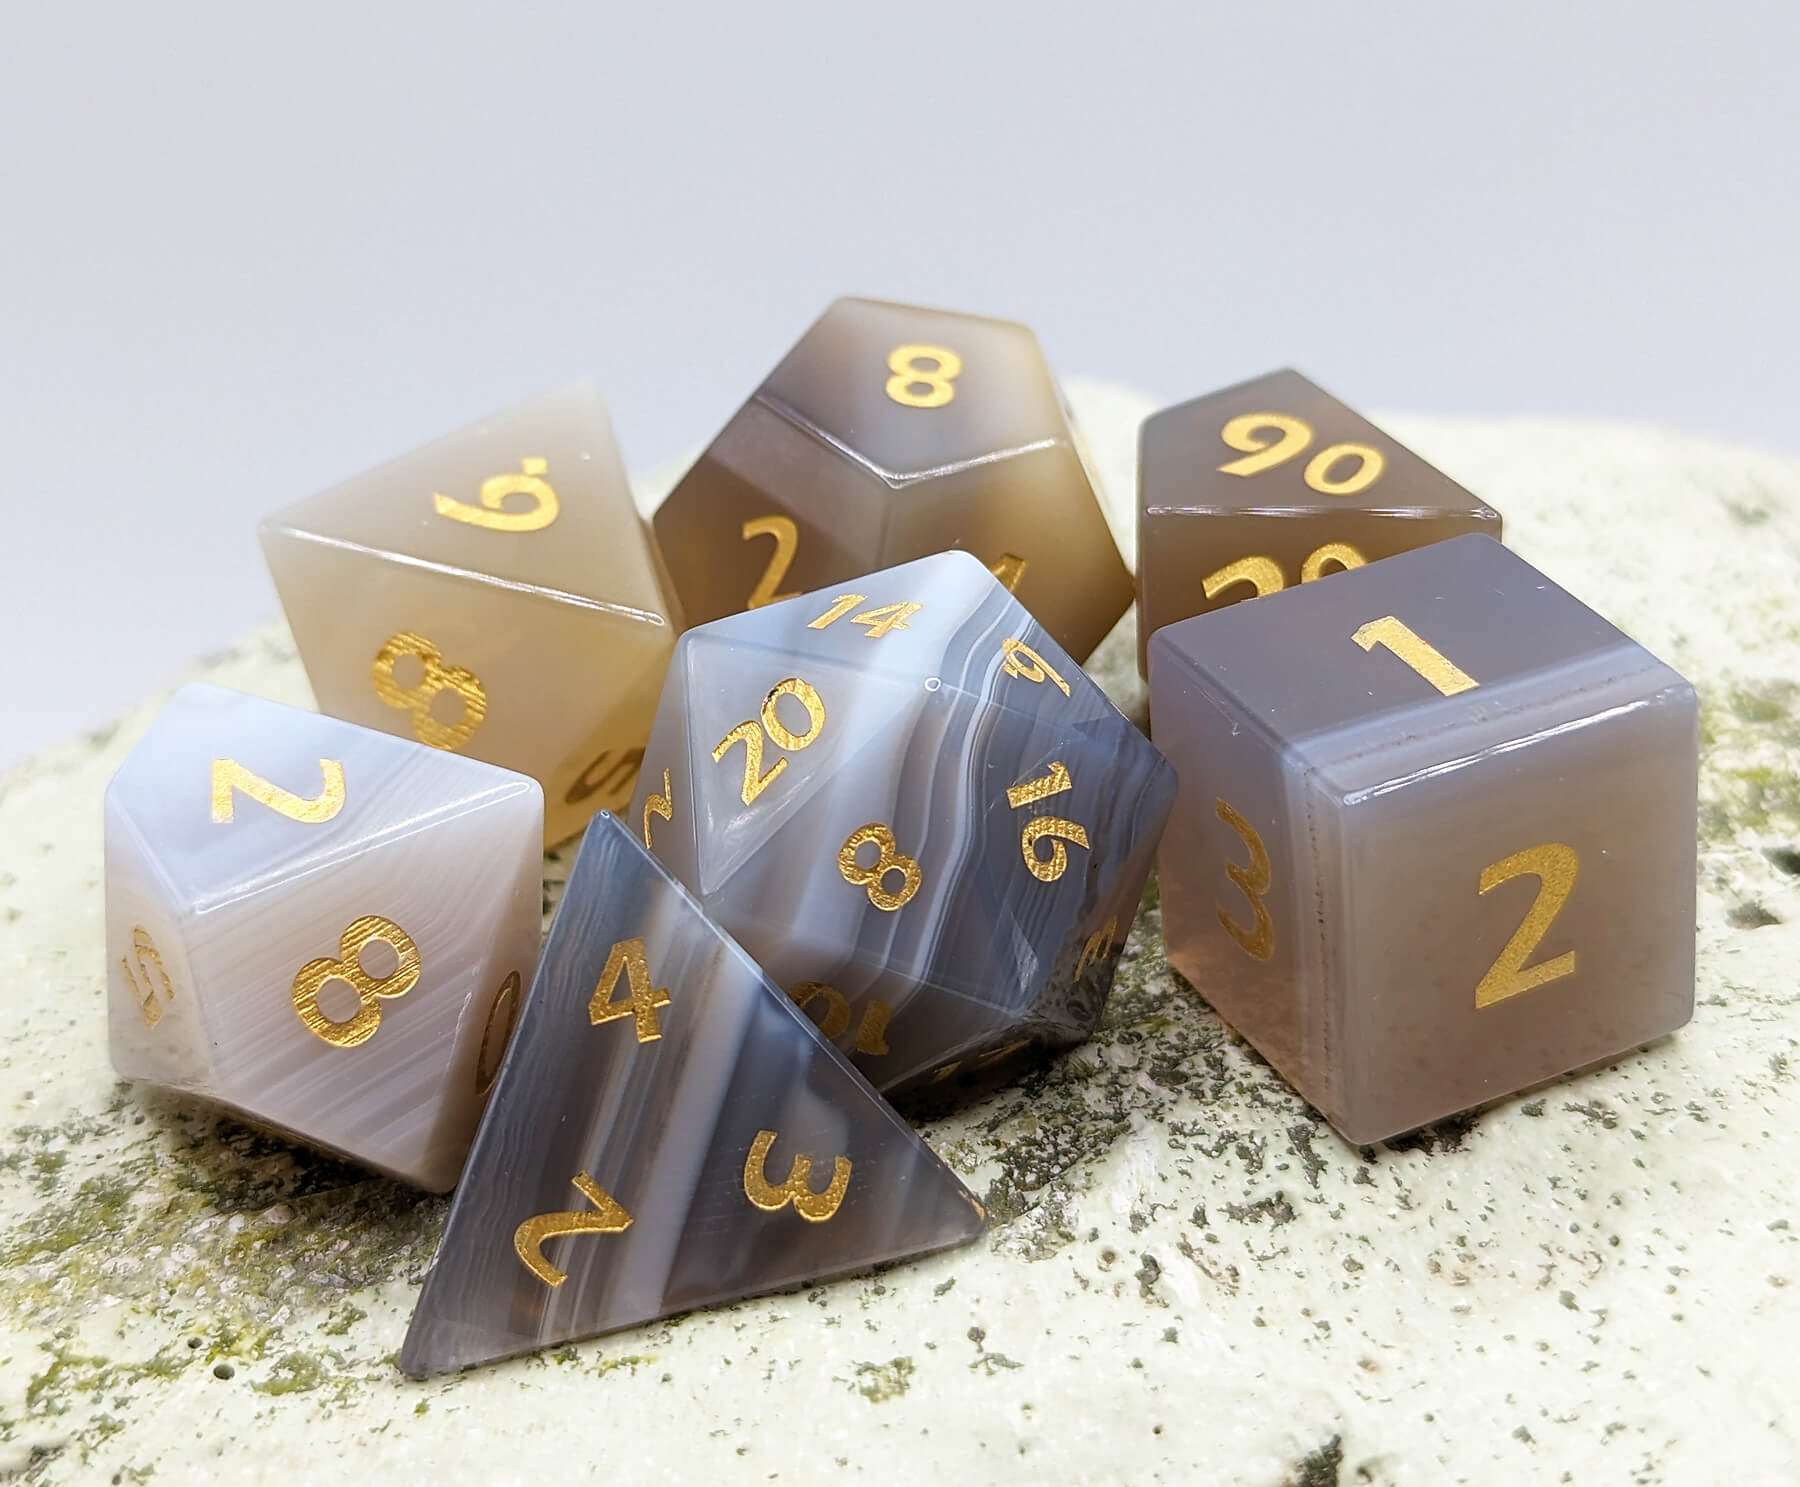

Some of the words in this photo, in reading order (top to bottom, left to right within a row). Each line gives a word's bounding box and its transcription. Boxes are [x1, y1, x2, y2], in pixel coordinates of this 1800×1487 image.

[886, 345, 962, 408] 8
[1217, 412, 1384, 495] 90
[743, 516, 801, 609] 2
[808, 594, 924, 639] 14
[1351, 614, 1480, 697] 1
[373, 632, 487, 750] 8
[711, 678, 826, 806] 20
[211, 757, 347, 825] 2
[643, 767, 673, 849] 2
[1007, 761, 1090, 882] 16
[837, 823, 922, 912] 8
[1216, 797, 1274, 962] 3
[1474, 841, 1580, 1009] 2
[291, 915, 422, 1049] 8
[588, 937, 672, 1044] 4
[743, 1130, 853, 1222] 3
[513, 1170, 635, 1288] 2
